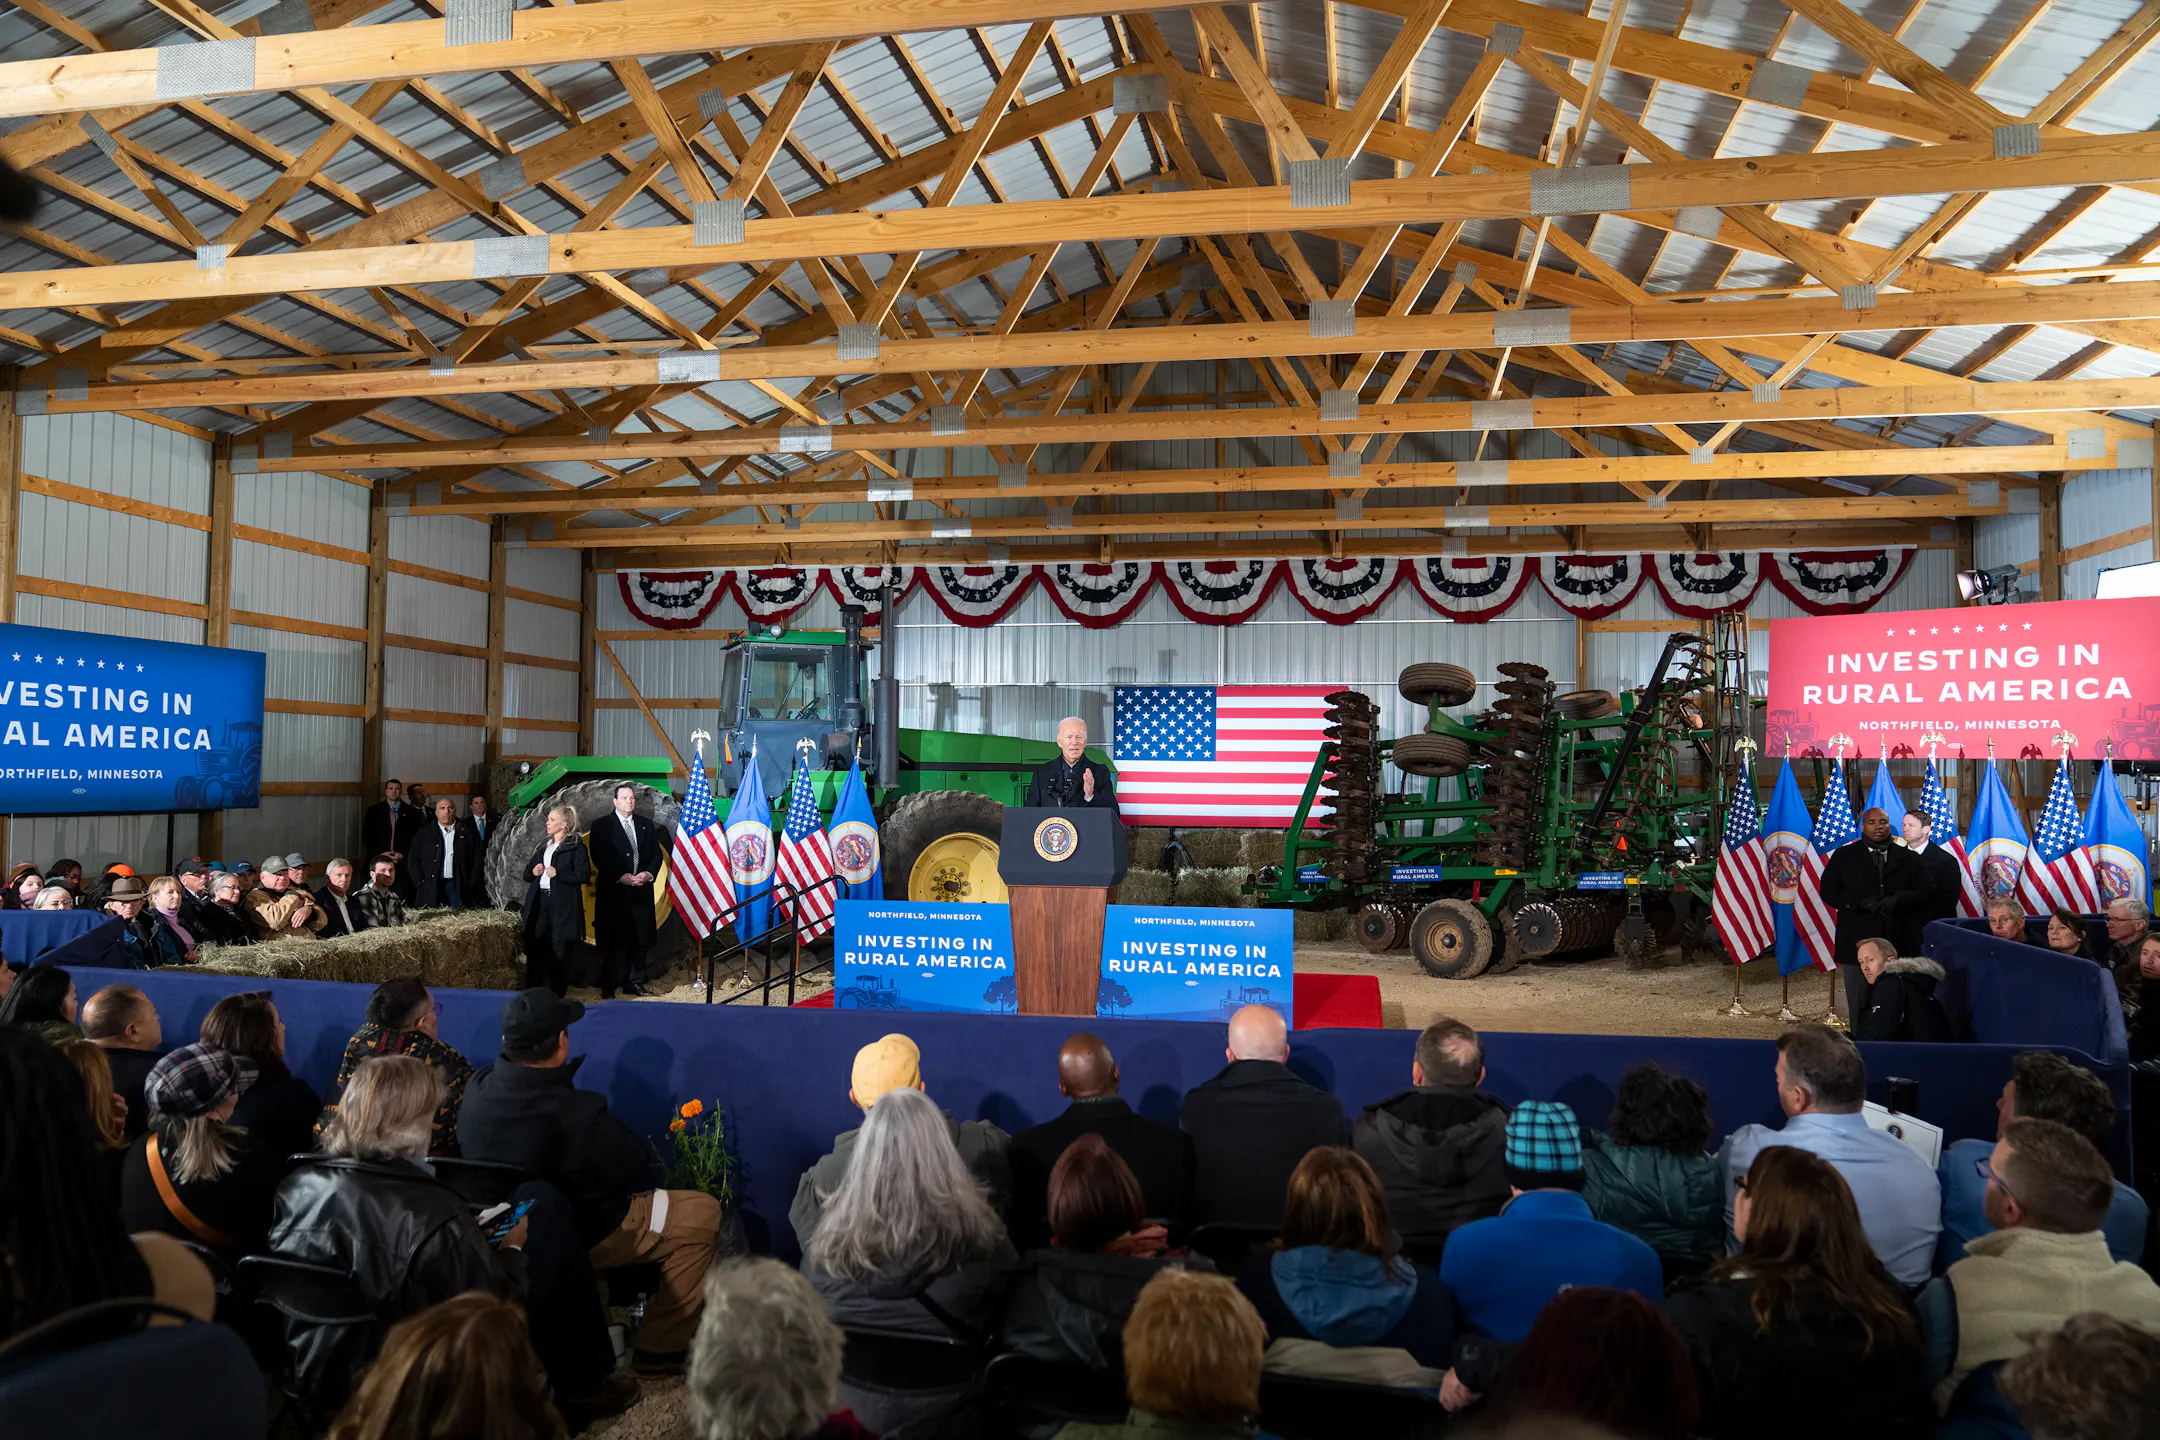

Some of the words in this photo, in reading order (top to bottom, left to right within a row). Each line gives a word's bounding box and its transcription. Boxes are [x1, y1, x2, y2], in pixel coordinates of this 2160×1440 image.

[1827, 645, 2040, 674] INVESTING
[2058, 643, 2099, 666] IN
[1803, 682, 1924, 705] RURAL
[1938, 676, 2132, 703] AMERICA
[162, 692, 192, 716] IN
[1859, 720, 1960, 732] NORTHFIELD,
[1965, 719, 2061, 730] MINNESOTA
[63, 723, 212, 751] AMERICA
[87, 769, 163, 779] MINNESOTA
[868, 911, 928, 921] NORTHFIELD,
[929, 913, 982, 921] MINNESOTA
[1134, 917, 1197, 927] NORTHFIELD,
[1199, 919, 1256, 928] MINNESOTA
[857, 934, 966, 951] INVESTING
[972, 937, 993, 951] IN
[1123, 941, 1238, 958] INVESTING
[1245, 945, 1267, 959] IN
[844, 951, 910, 966] RURAL
[915, 954, 1007, 970] AMERICA
[1109, 959, 1178, 975] RURAL
[1184, 961, 1282, 978] AMERICA
